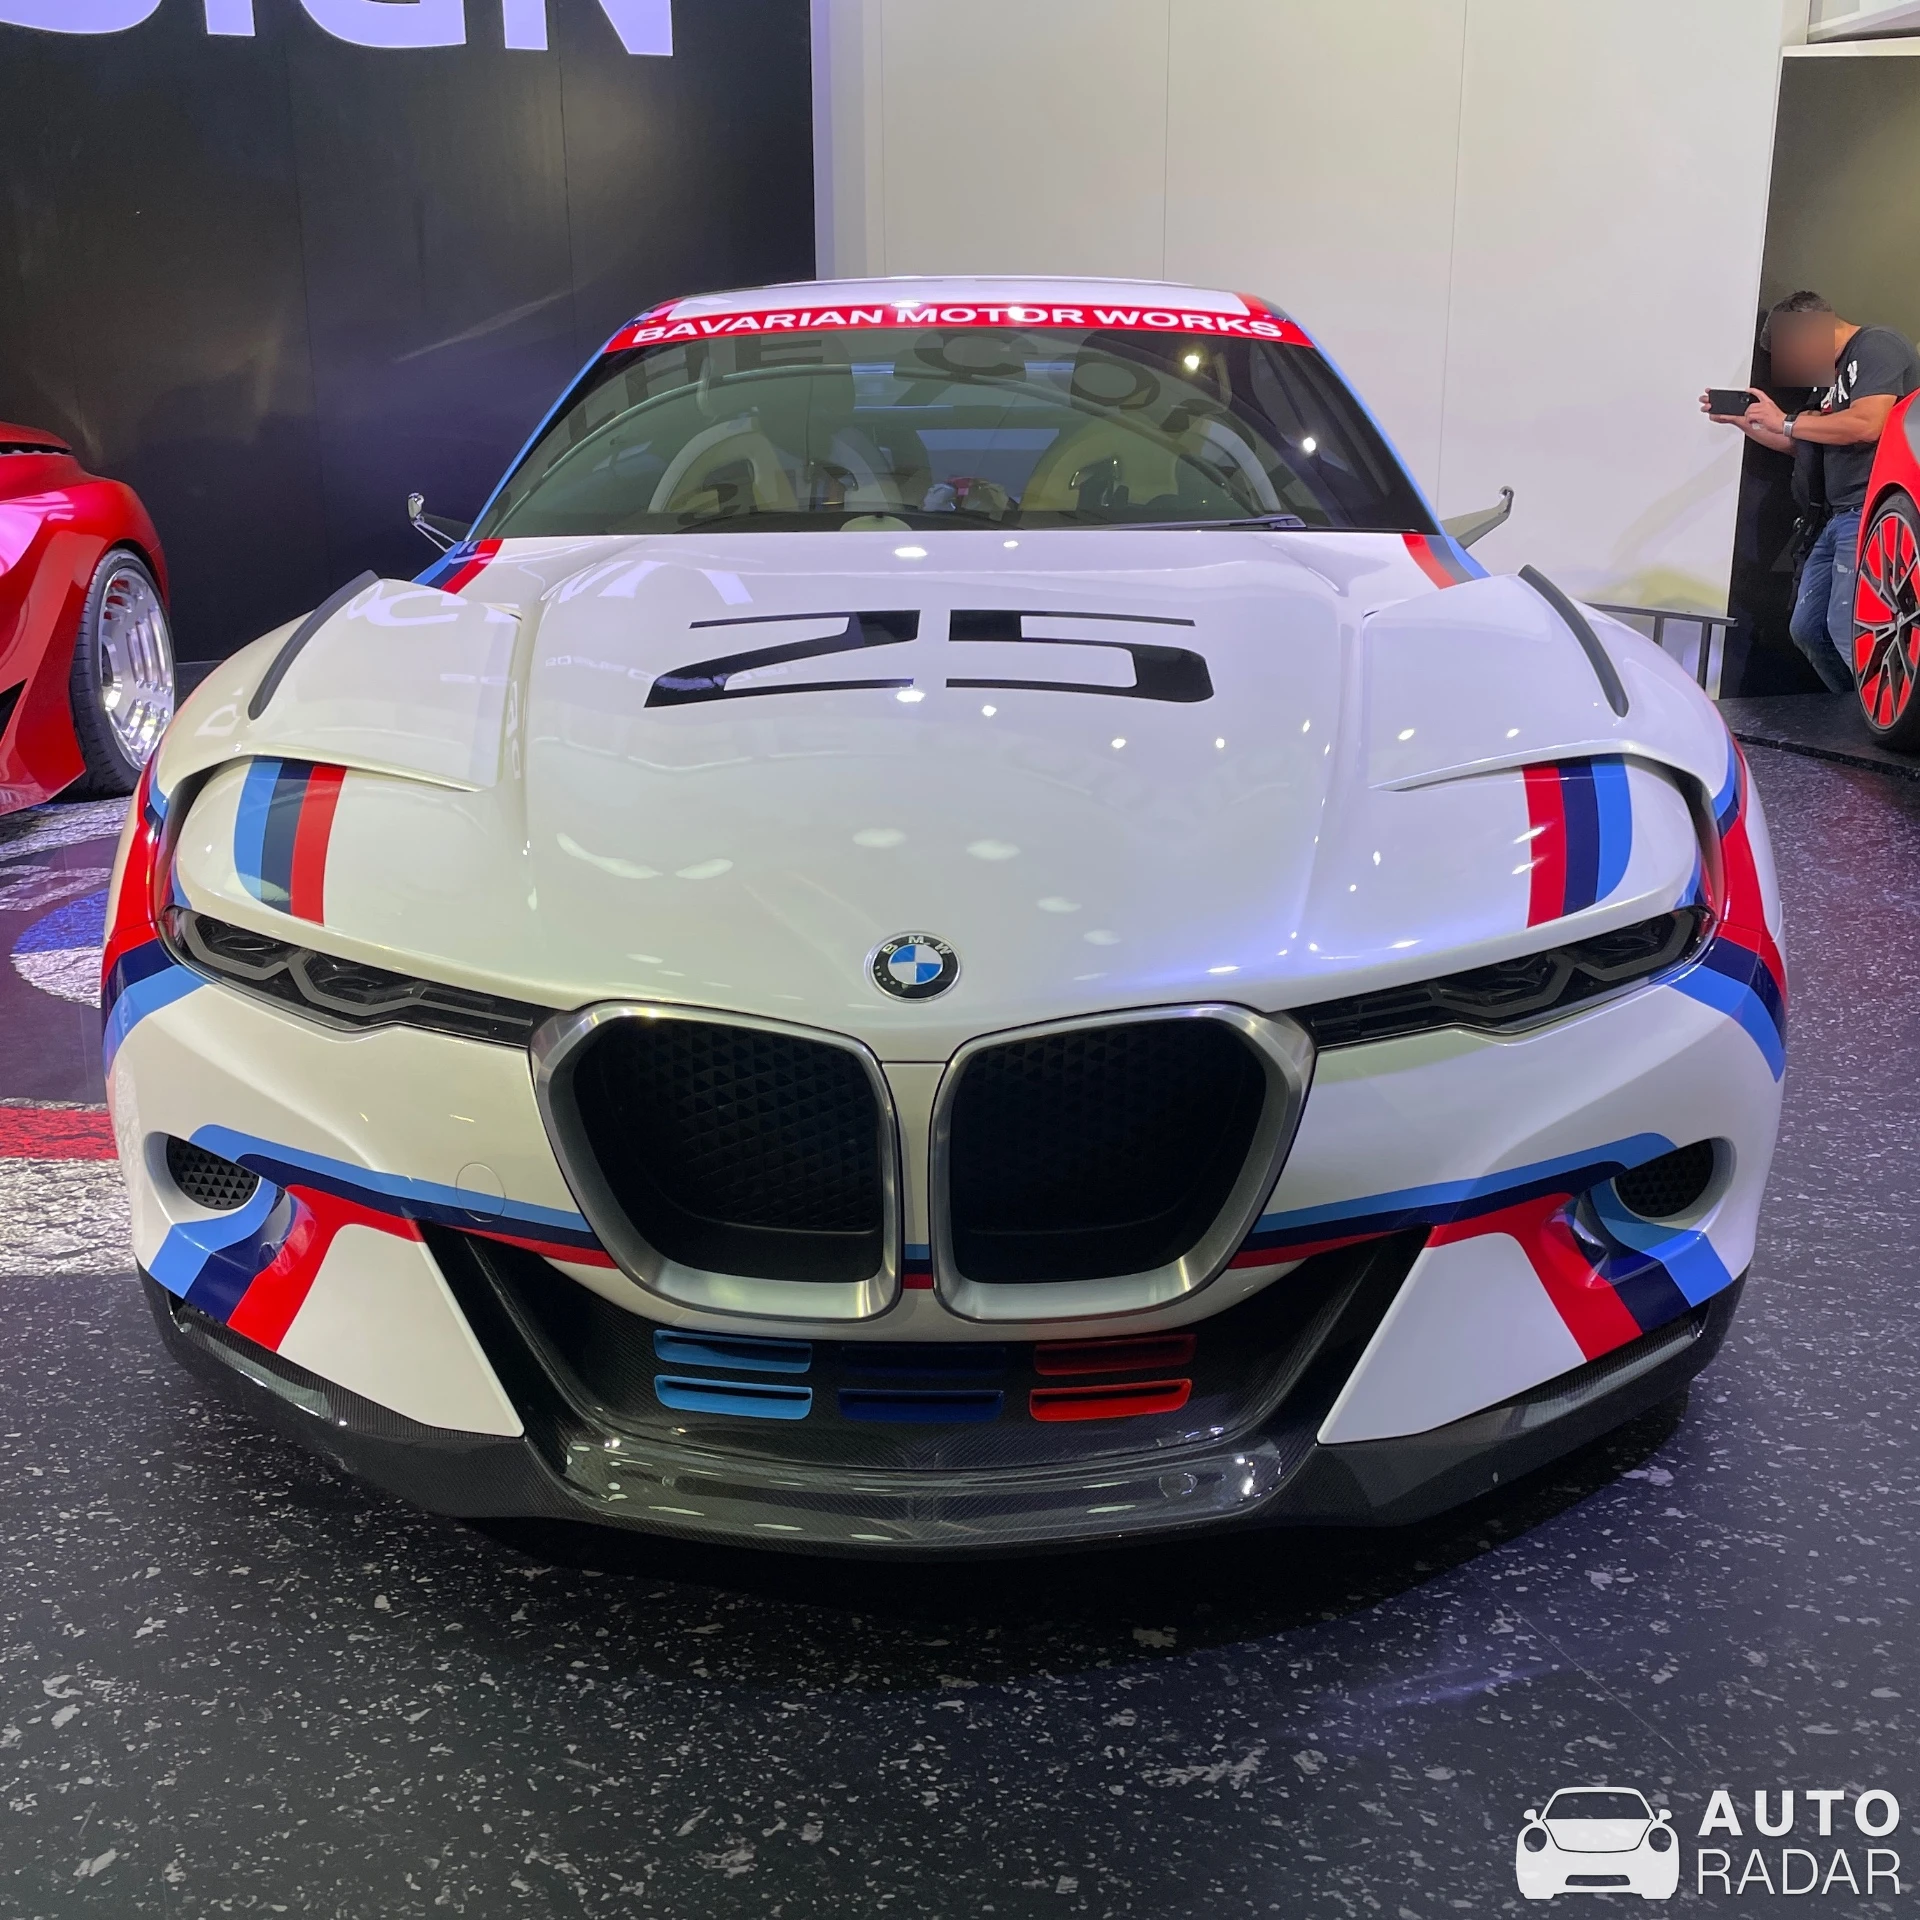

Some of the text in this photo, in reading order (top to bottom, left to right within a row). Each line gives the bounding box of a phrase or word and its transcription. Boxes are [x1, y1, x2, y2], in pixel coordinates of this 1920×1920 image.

[631, 306, 1283, 344] BAVARIAN MOTOR WORKS
[643, 608, 1215, 709] 25
[881, 935, 953, 955] BMW
